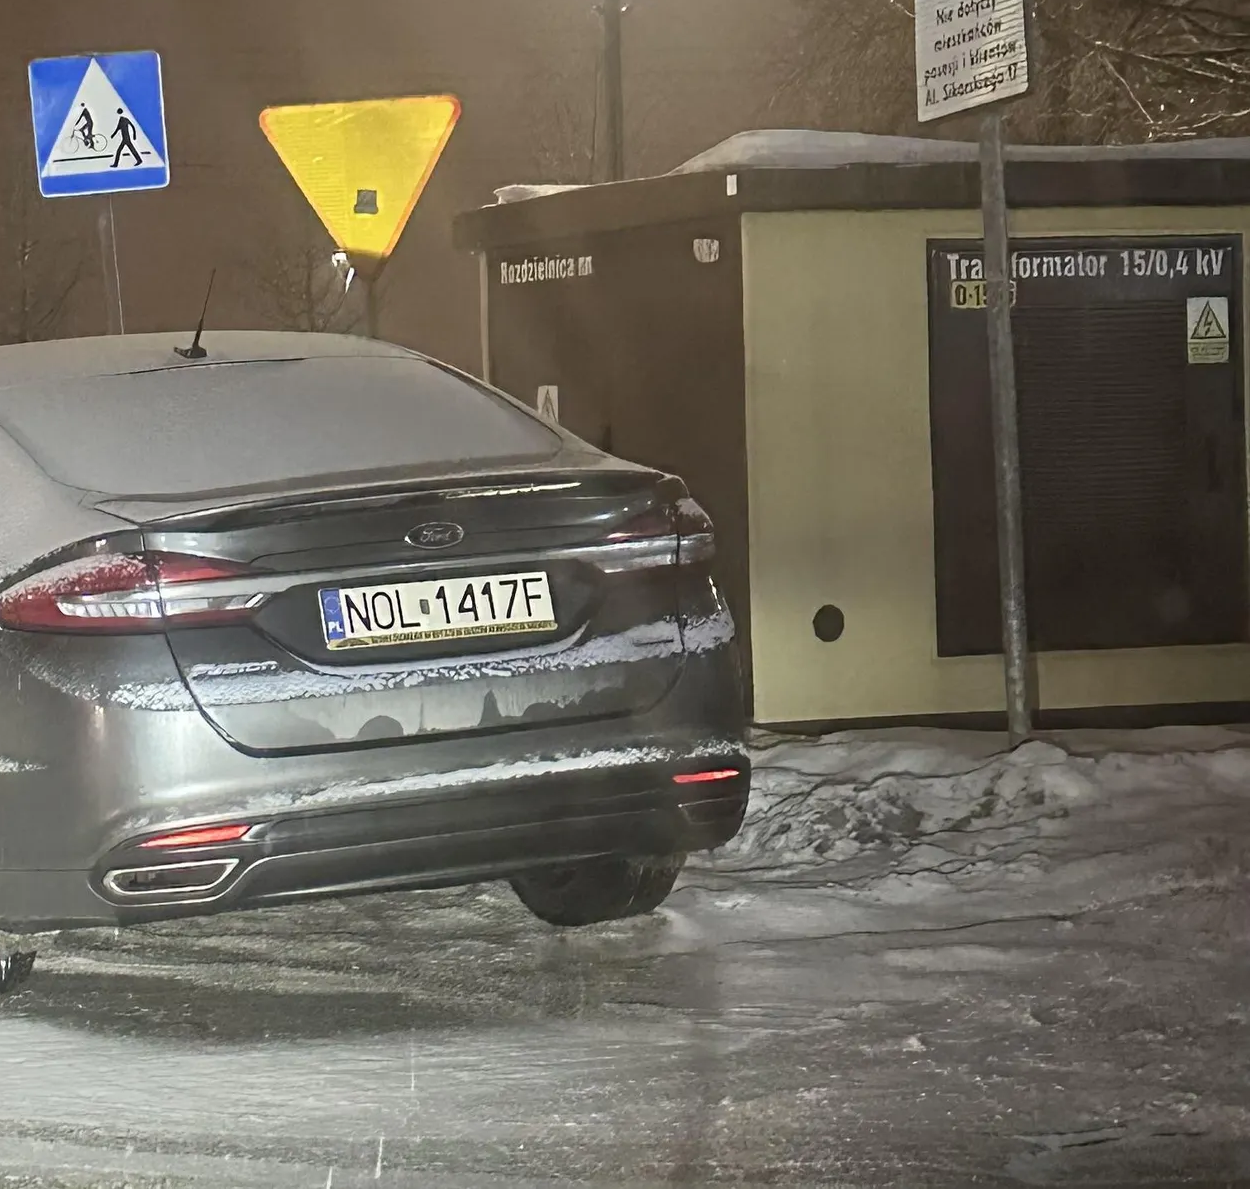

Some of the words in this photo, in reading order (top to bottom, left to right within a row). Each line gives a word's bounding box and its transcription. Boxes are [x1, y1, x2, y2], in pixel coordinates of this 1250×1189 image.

[936, 8, 953, 25] Nie
[500, 254, 575, 284] Rozdzielnica
[946, 250, 1108, 281] Traformator
[1120, 249, 1188, 279] 15/0,4
[1196, 247, 1224, 276] kV
[344, 589, 421, 634] NOL
[435, 577, 543, 624] 1417F
[327, 620, 344, 633] PL
